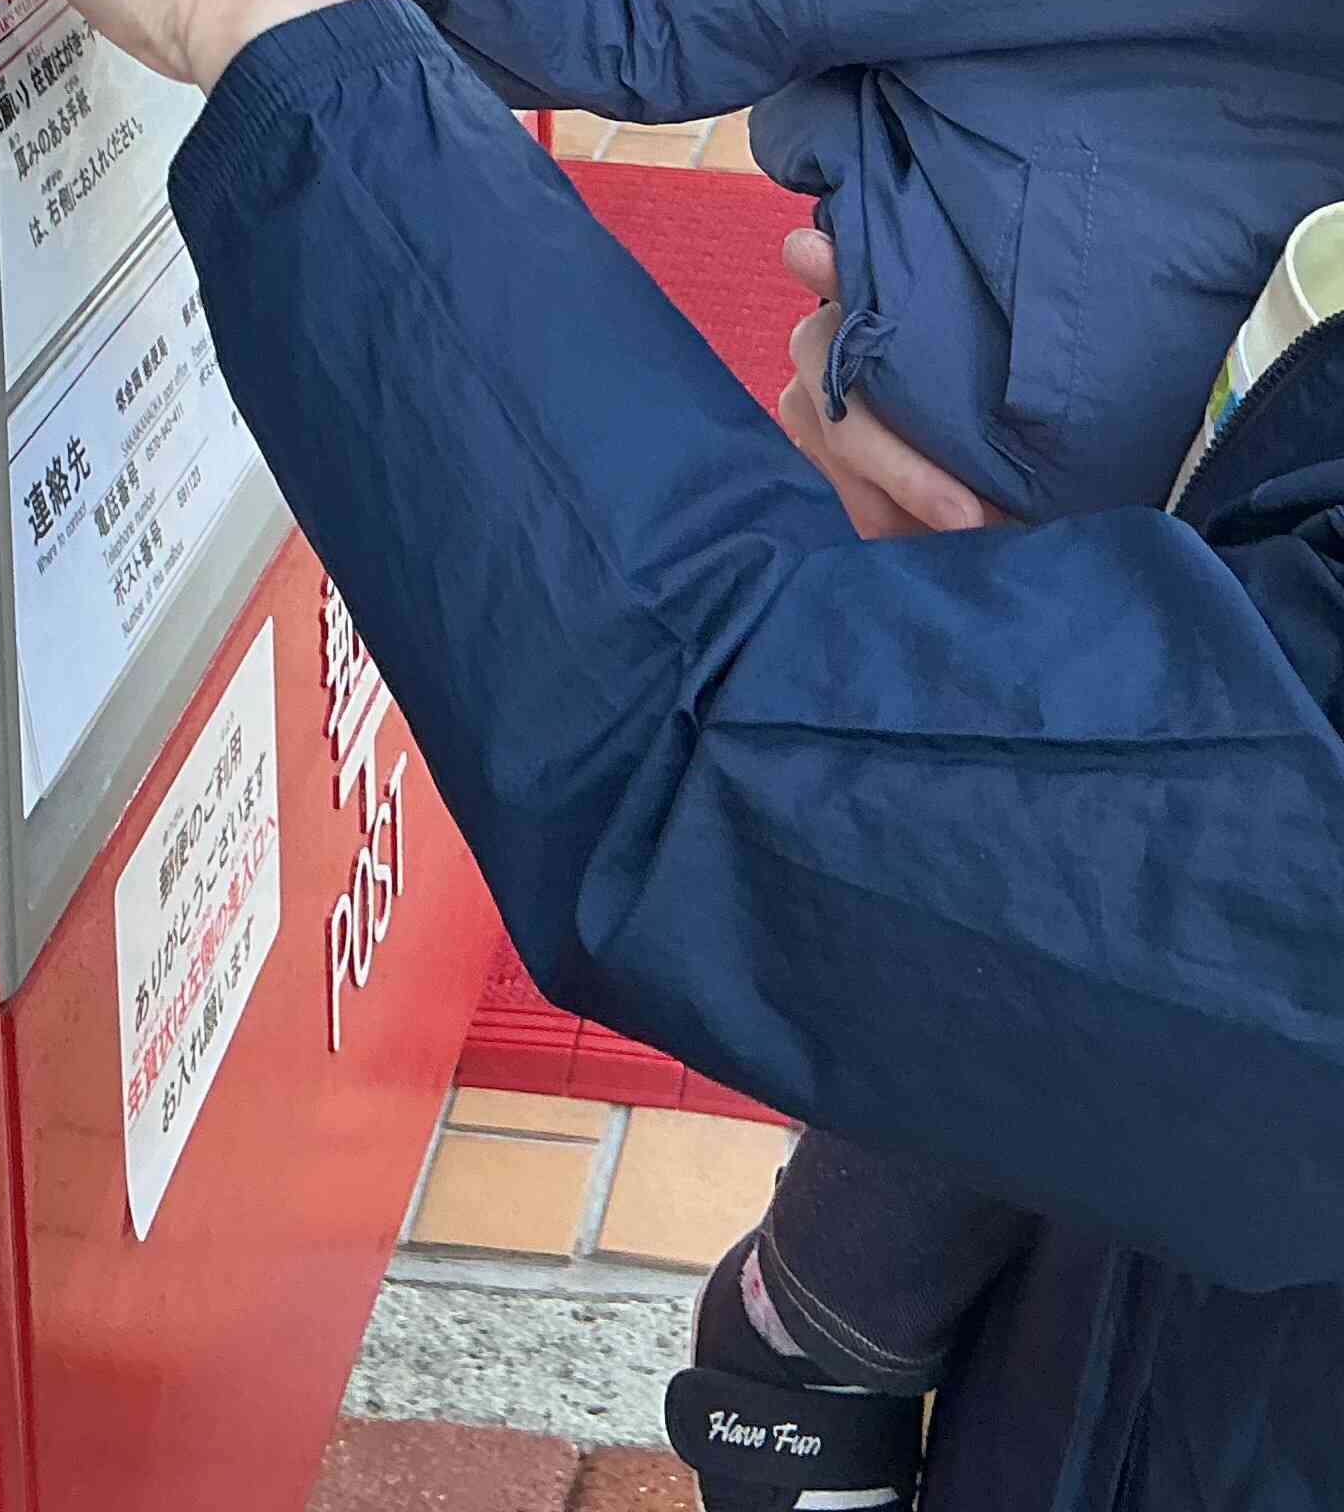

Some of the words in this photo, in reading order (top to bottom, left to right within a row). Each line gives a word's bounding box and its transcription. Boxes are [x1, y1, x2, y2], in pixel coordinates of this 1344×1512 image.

[29, 116, 144, 248] は、右側にお入れください。
[24, 434, 91, 546] 連絡先
[94, 460, 140, 538] 電話番号
[113, 520, 162, 606] ポスト番号
[159, 725, 242, 910] 郵便のご利用
[135, 751, 266, 1032] ありがとうございます
[330, 751, 408, 1052] POST
[162, 914, 254, 1134] お入れ願います
[708, 1410, 766, 1449] Have
[772, 1420, 822, 1457] Fun
